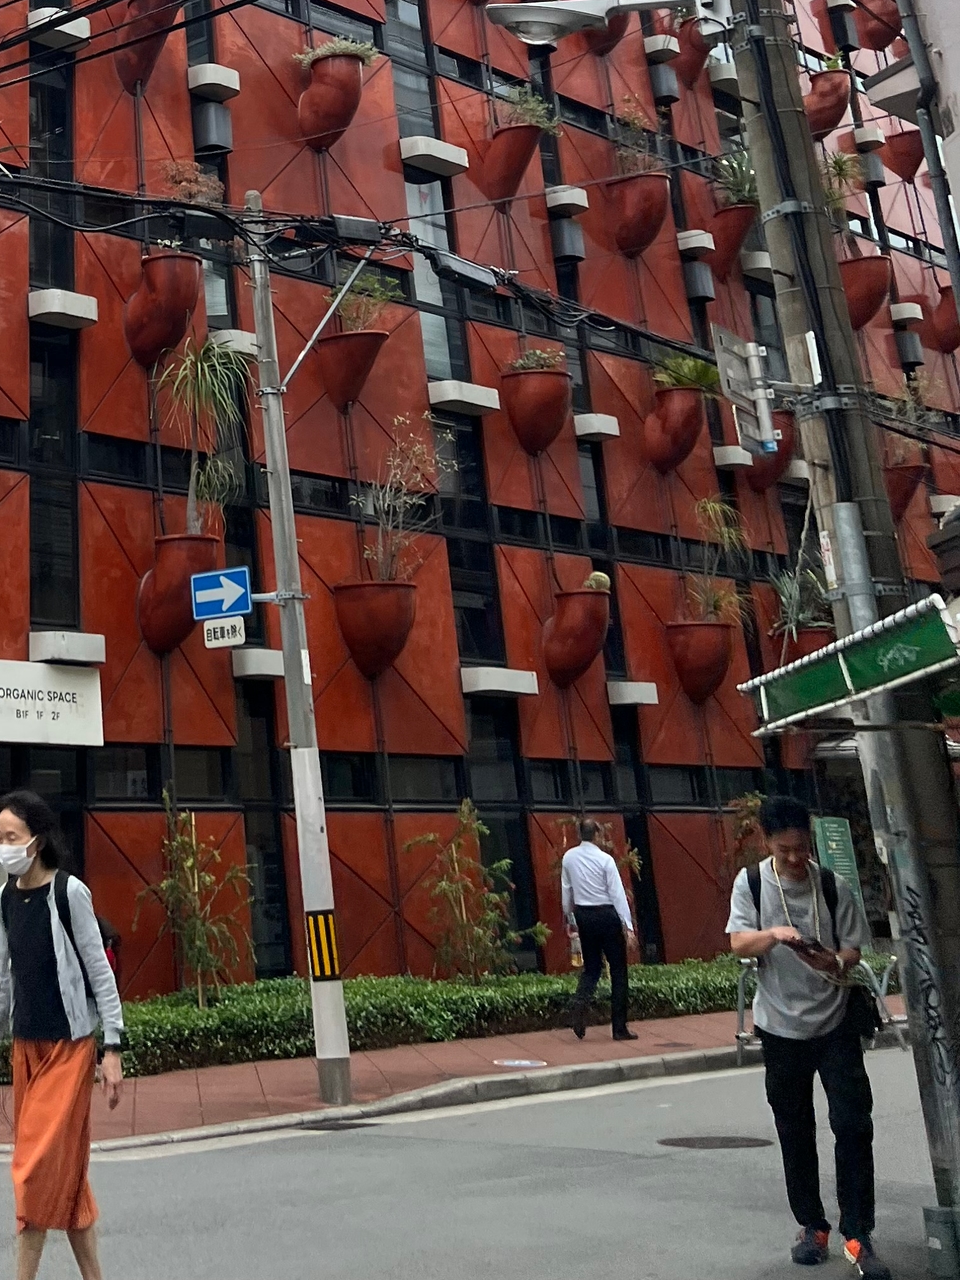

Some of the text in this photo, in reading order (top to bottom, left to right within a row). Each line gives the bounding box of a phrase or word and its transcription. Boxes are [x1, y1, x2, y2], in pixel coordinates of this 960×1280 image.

[46, 690, 77, 704] SPACE
[15, 709, 61, 721] B1F 1F 2F
